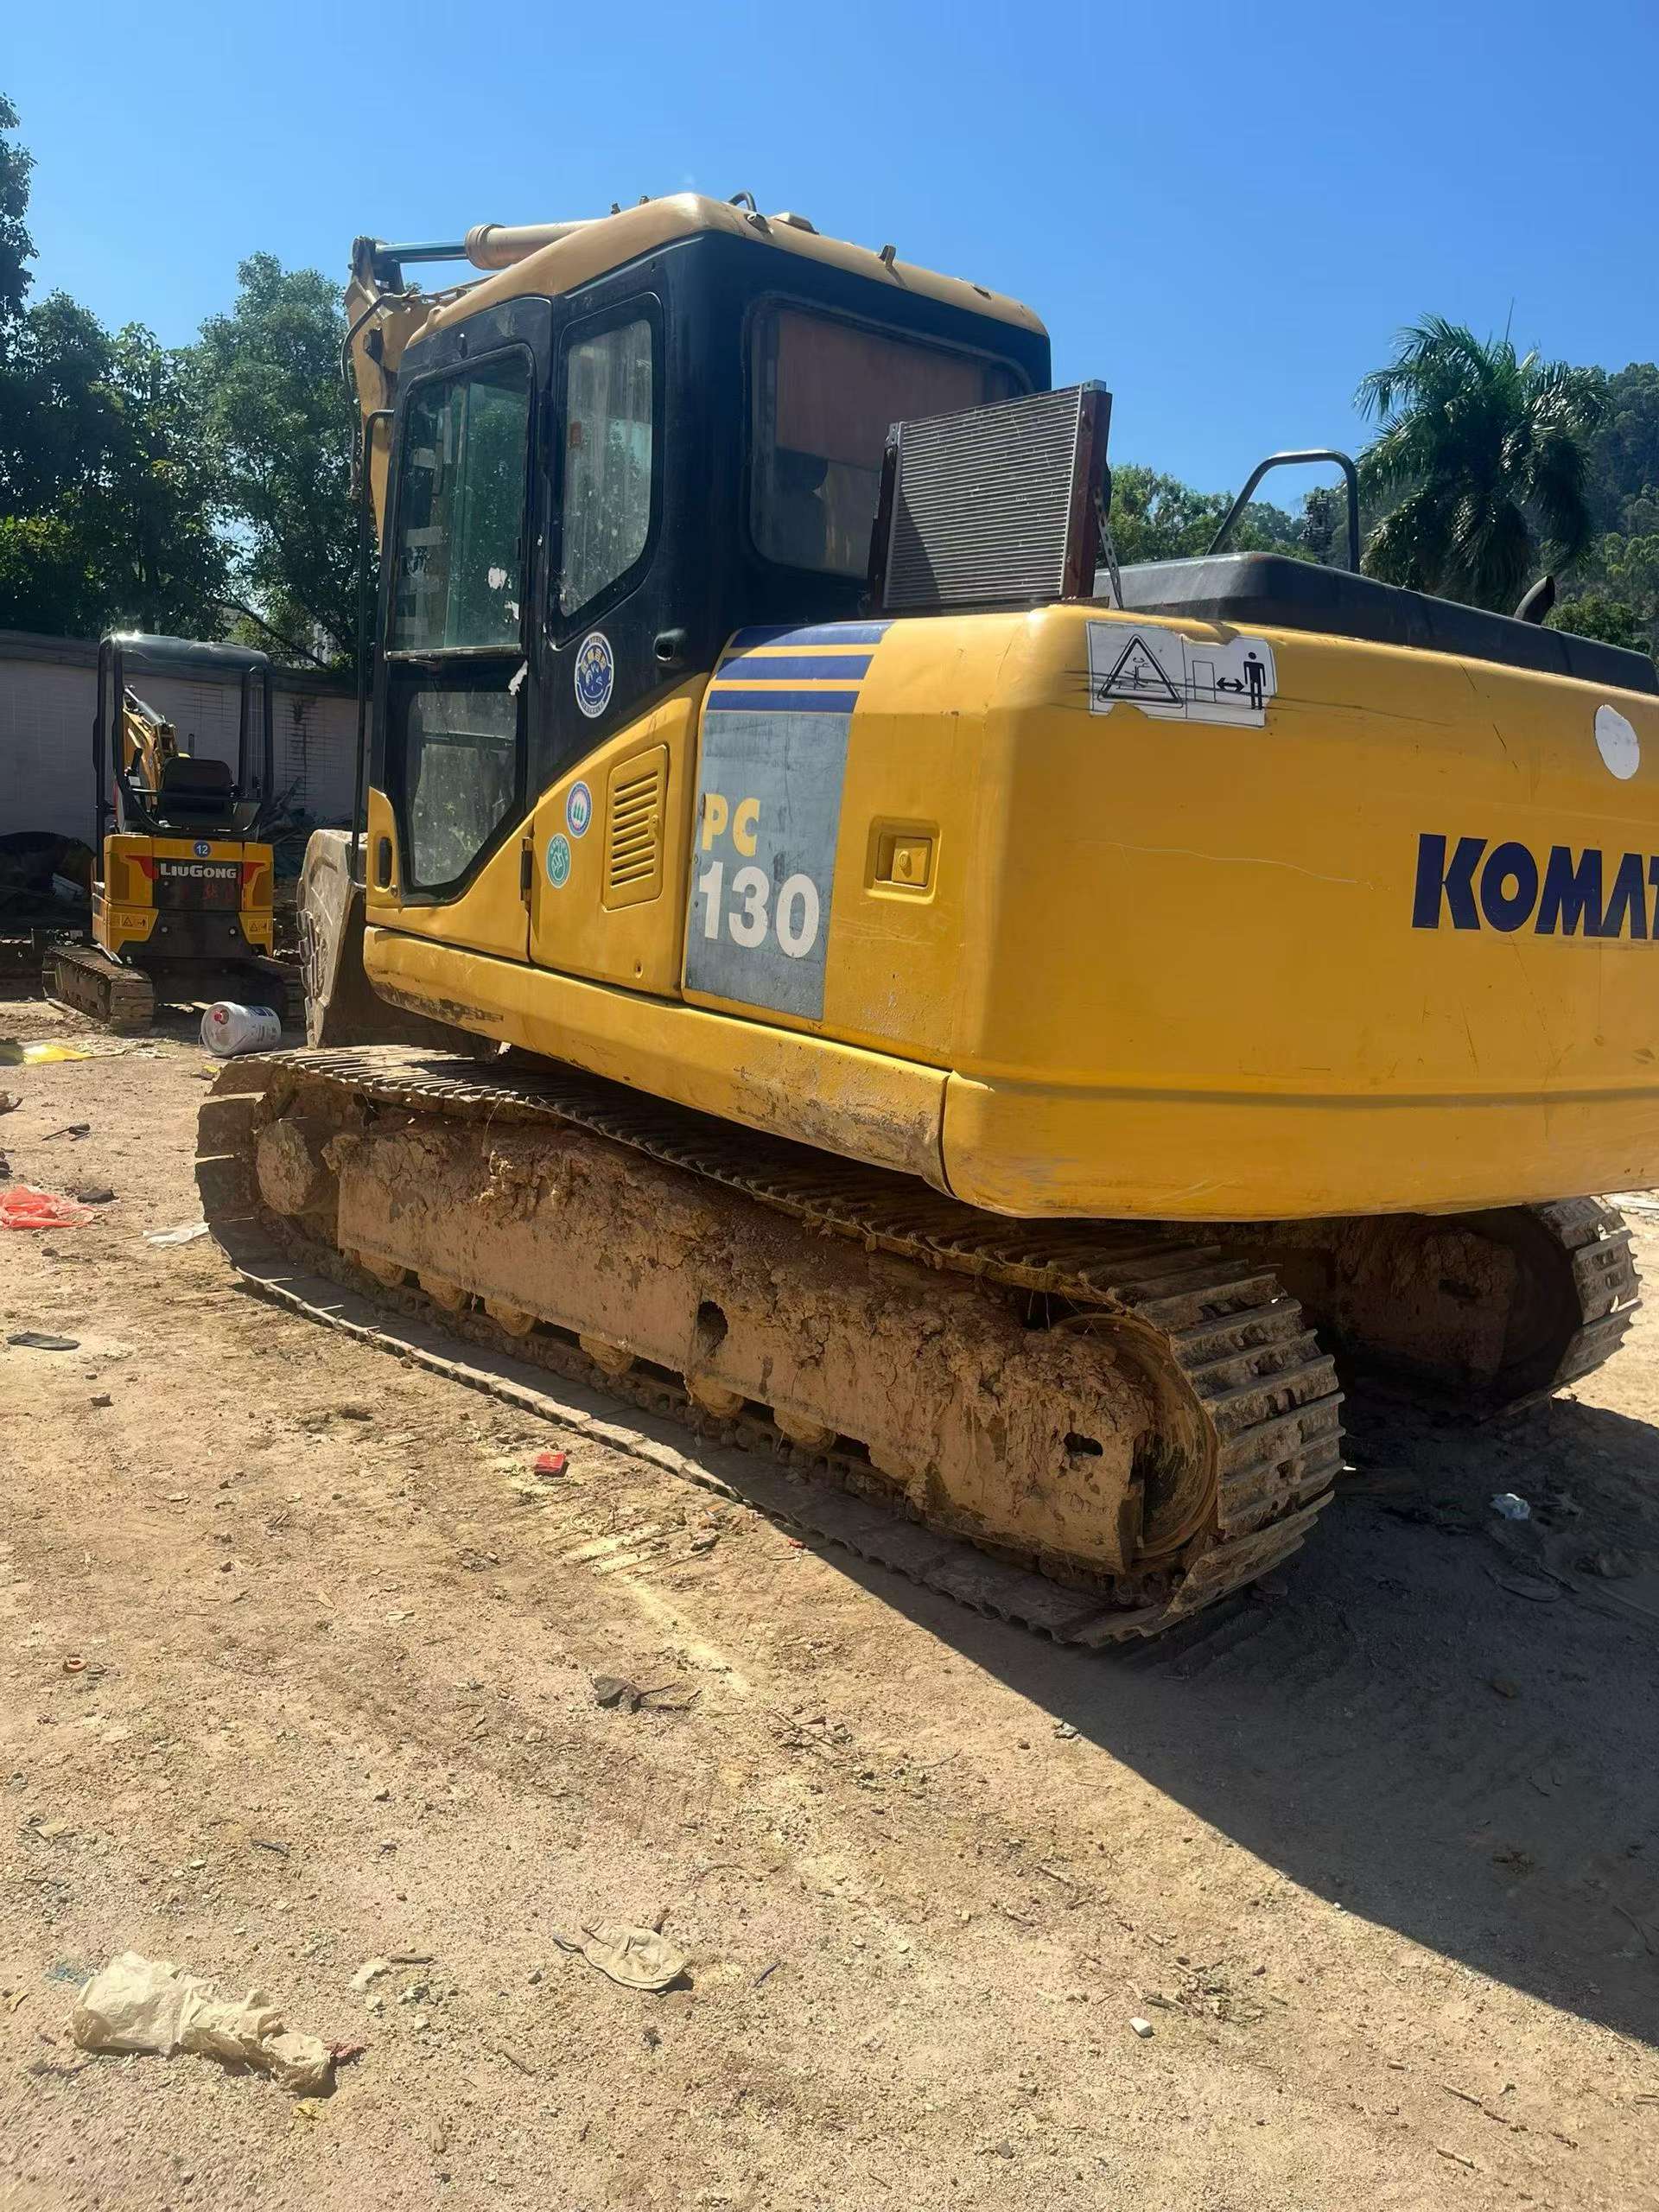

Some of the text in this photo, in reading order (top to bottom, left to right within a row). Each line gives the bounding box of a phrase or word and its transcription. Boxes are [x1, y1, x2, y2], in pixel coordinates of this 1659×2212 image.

[196, 844, 208, 855] 12
[702, 793, 761, 857] PC
[699, 861, 820, 958] 130
[1412, 833, 1659, 940] KOMA
